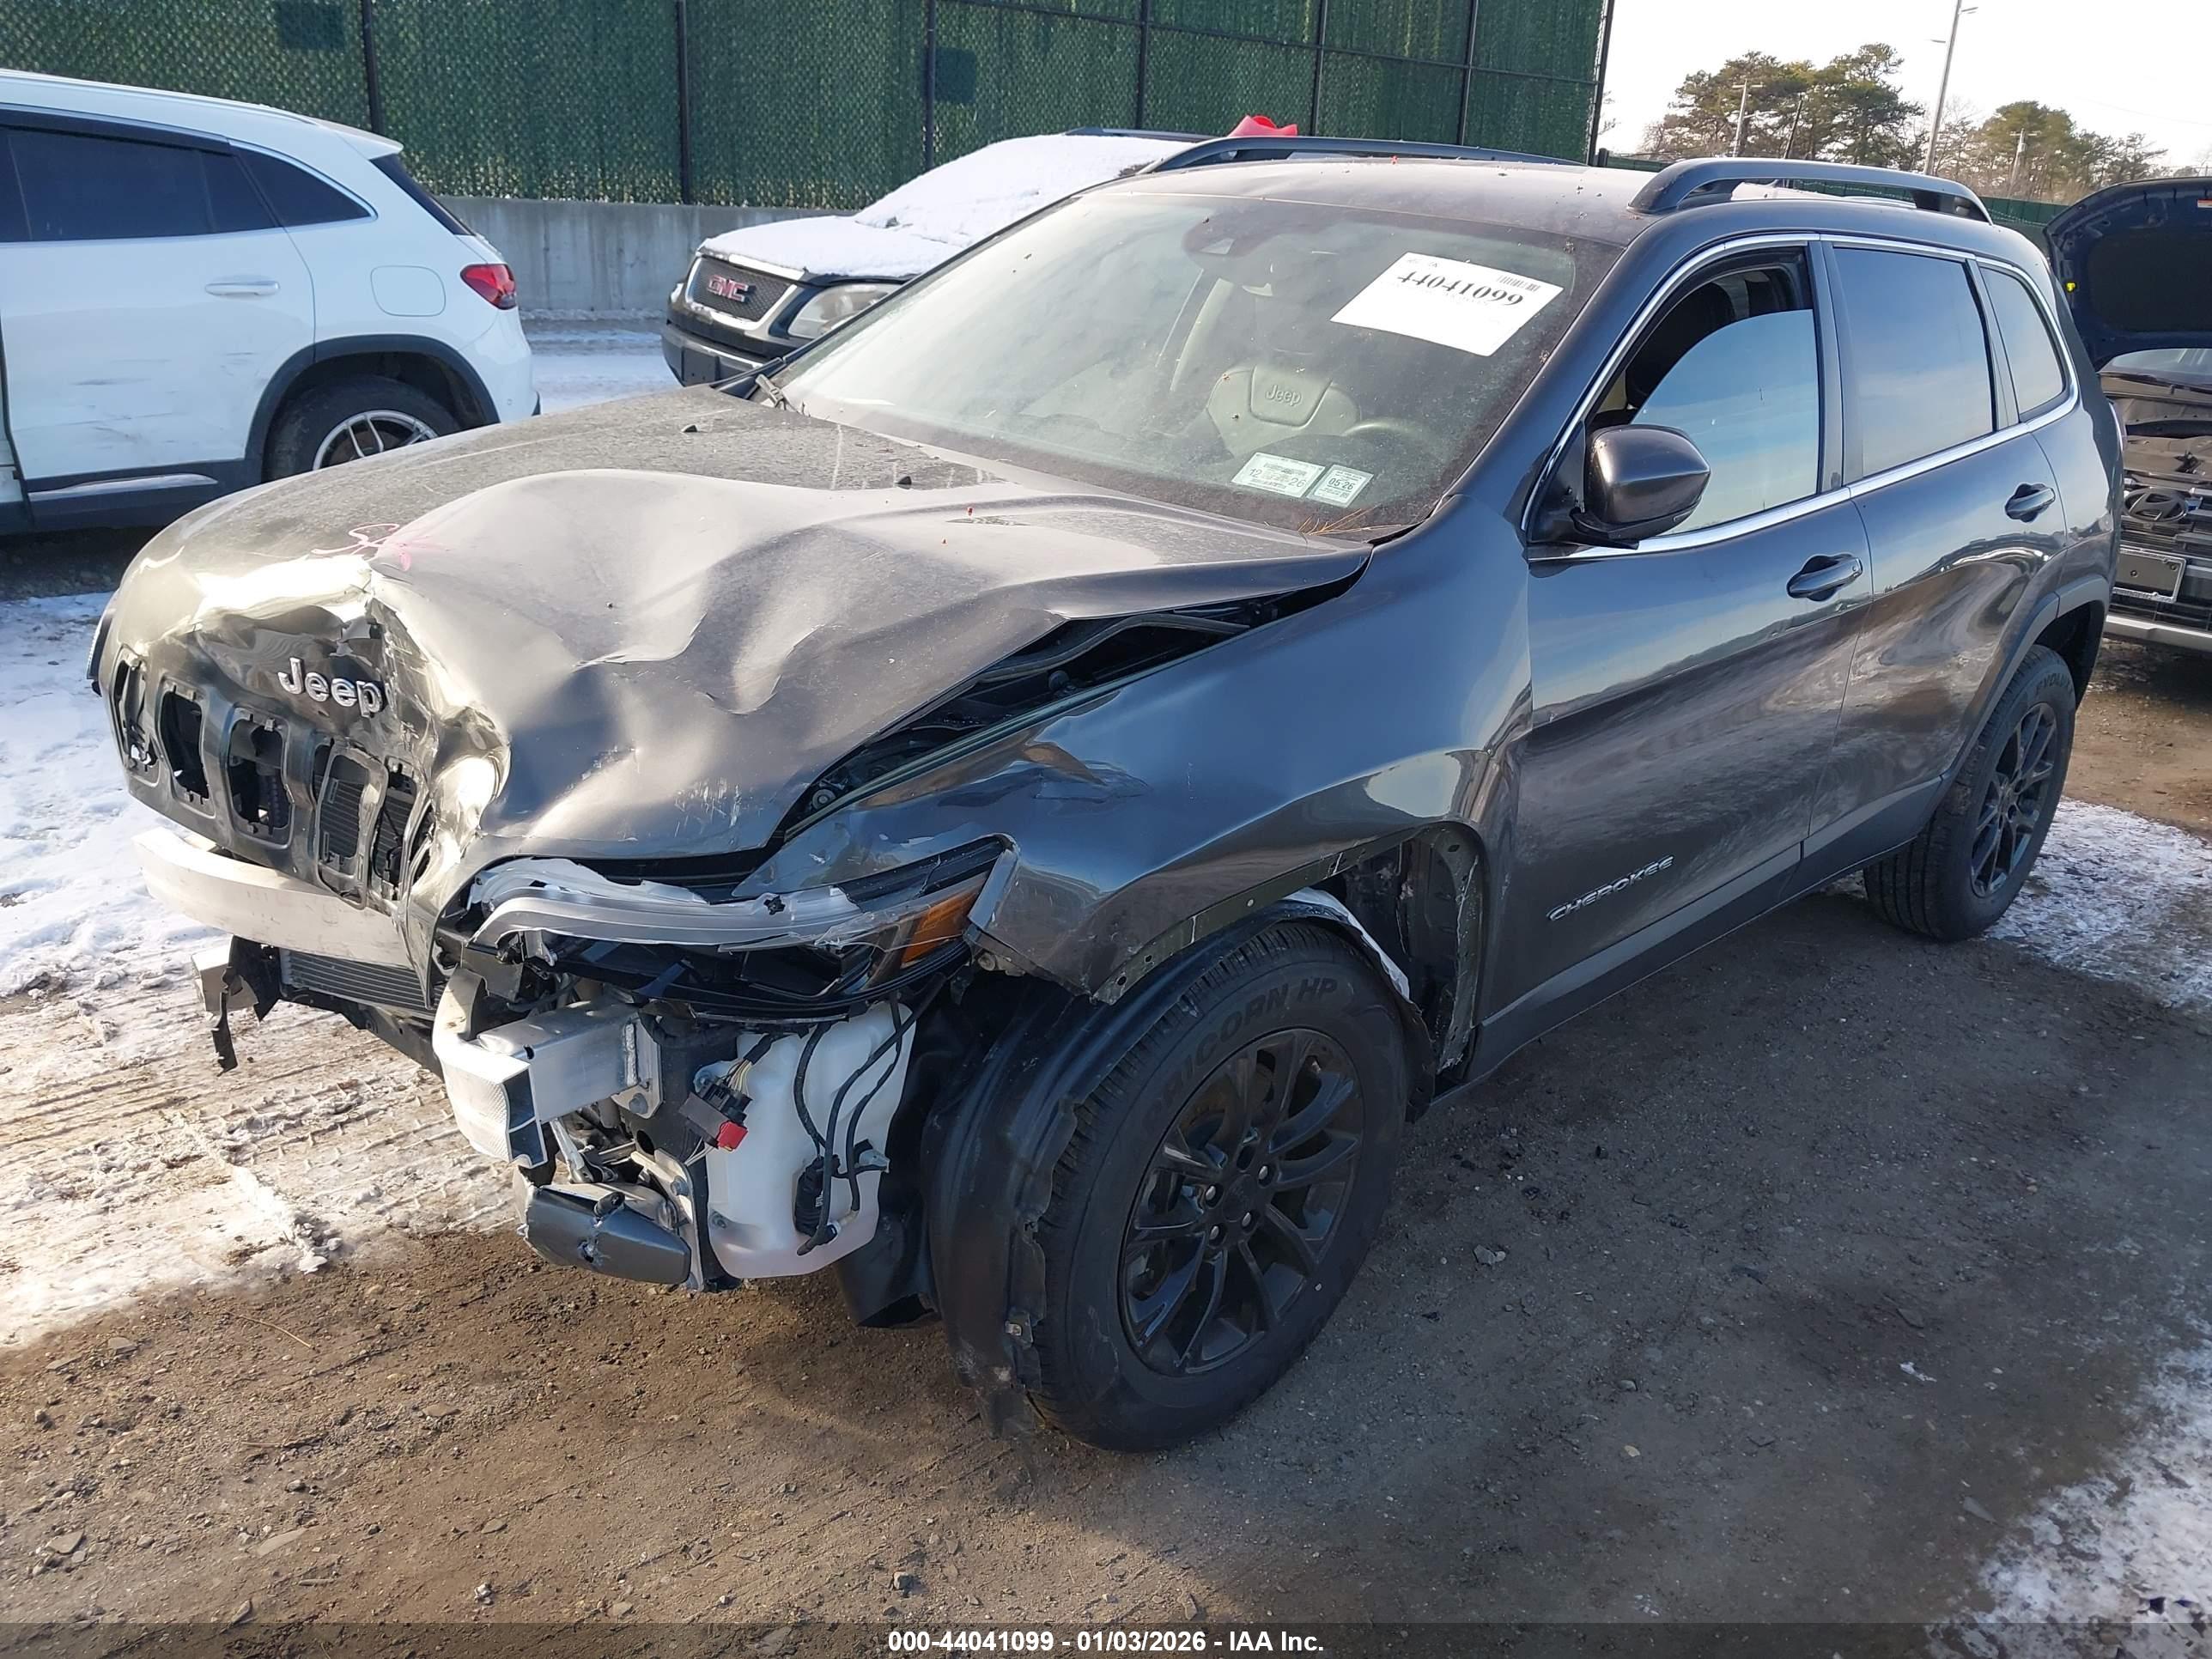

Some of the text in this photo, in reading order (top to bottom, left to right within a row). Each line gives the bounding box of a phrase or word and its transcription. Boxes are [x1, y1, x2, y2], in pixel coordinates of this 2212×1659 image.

[707, 275, 749, 303] GMC
[1397, 270, 1524, 307] 44041099
[1265, 384, 1304, 407] Jeep
[277, 657, 383, 719] Jeep
[1547, 854, 1674, 921] CHEROKEE
[1297, 976, 1338, 1003] HP
